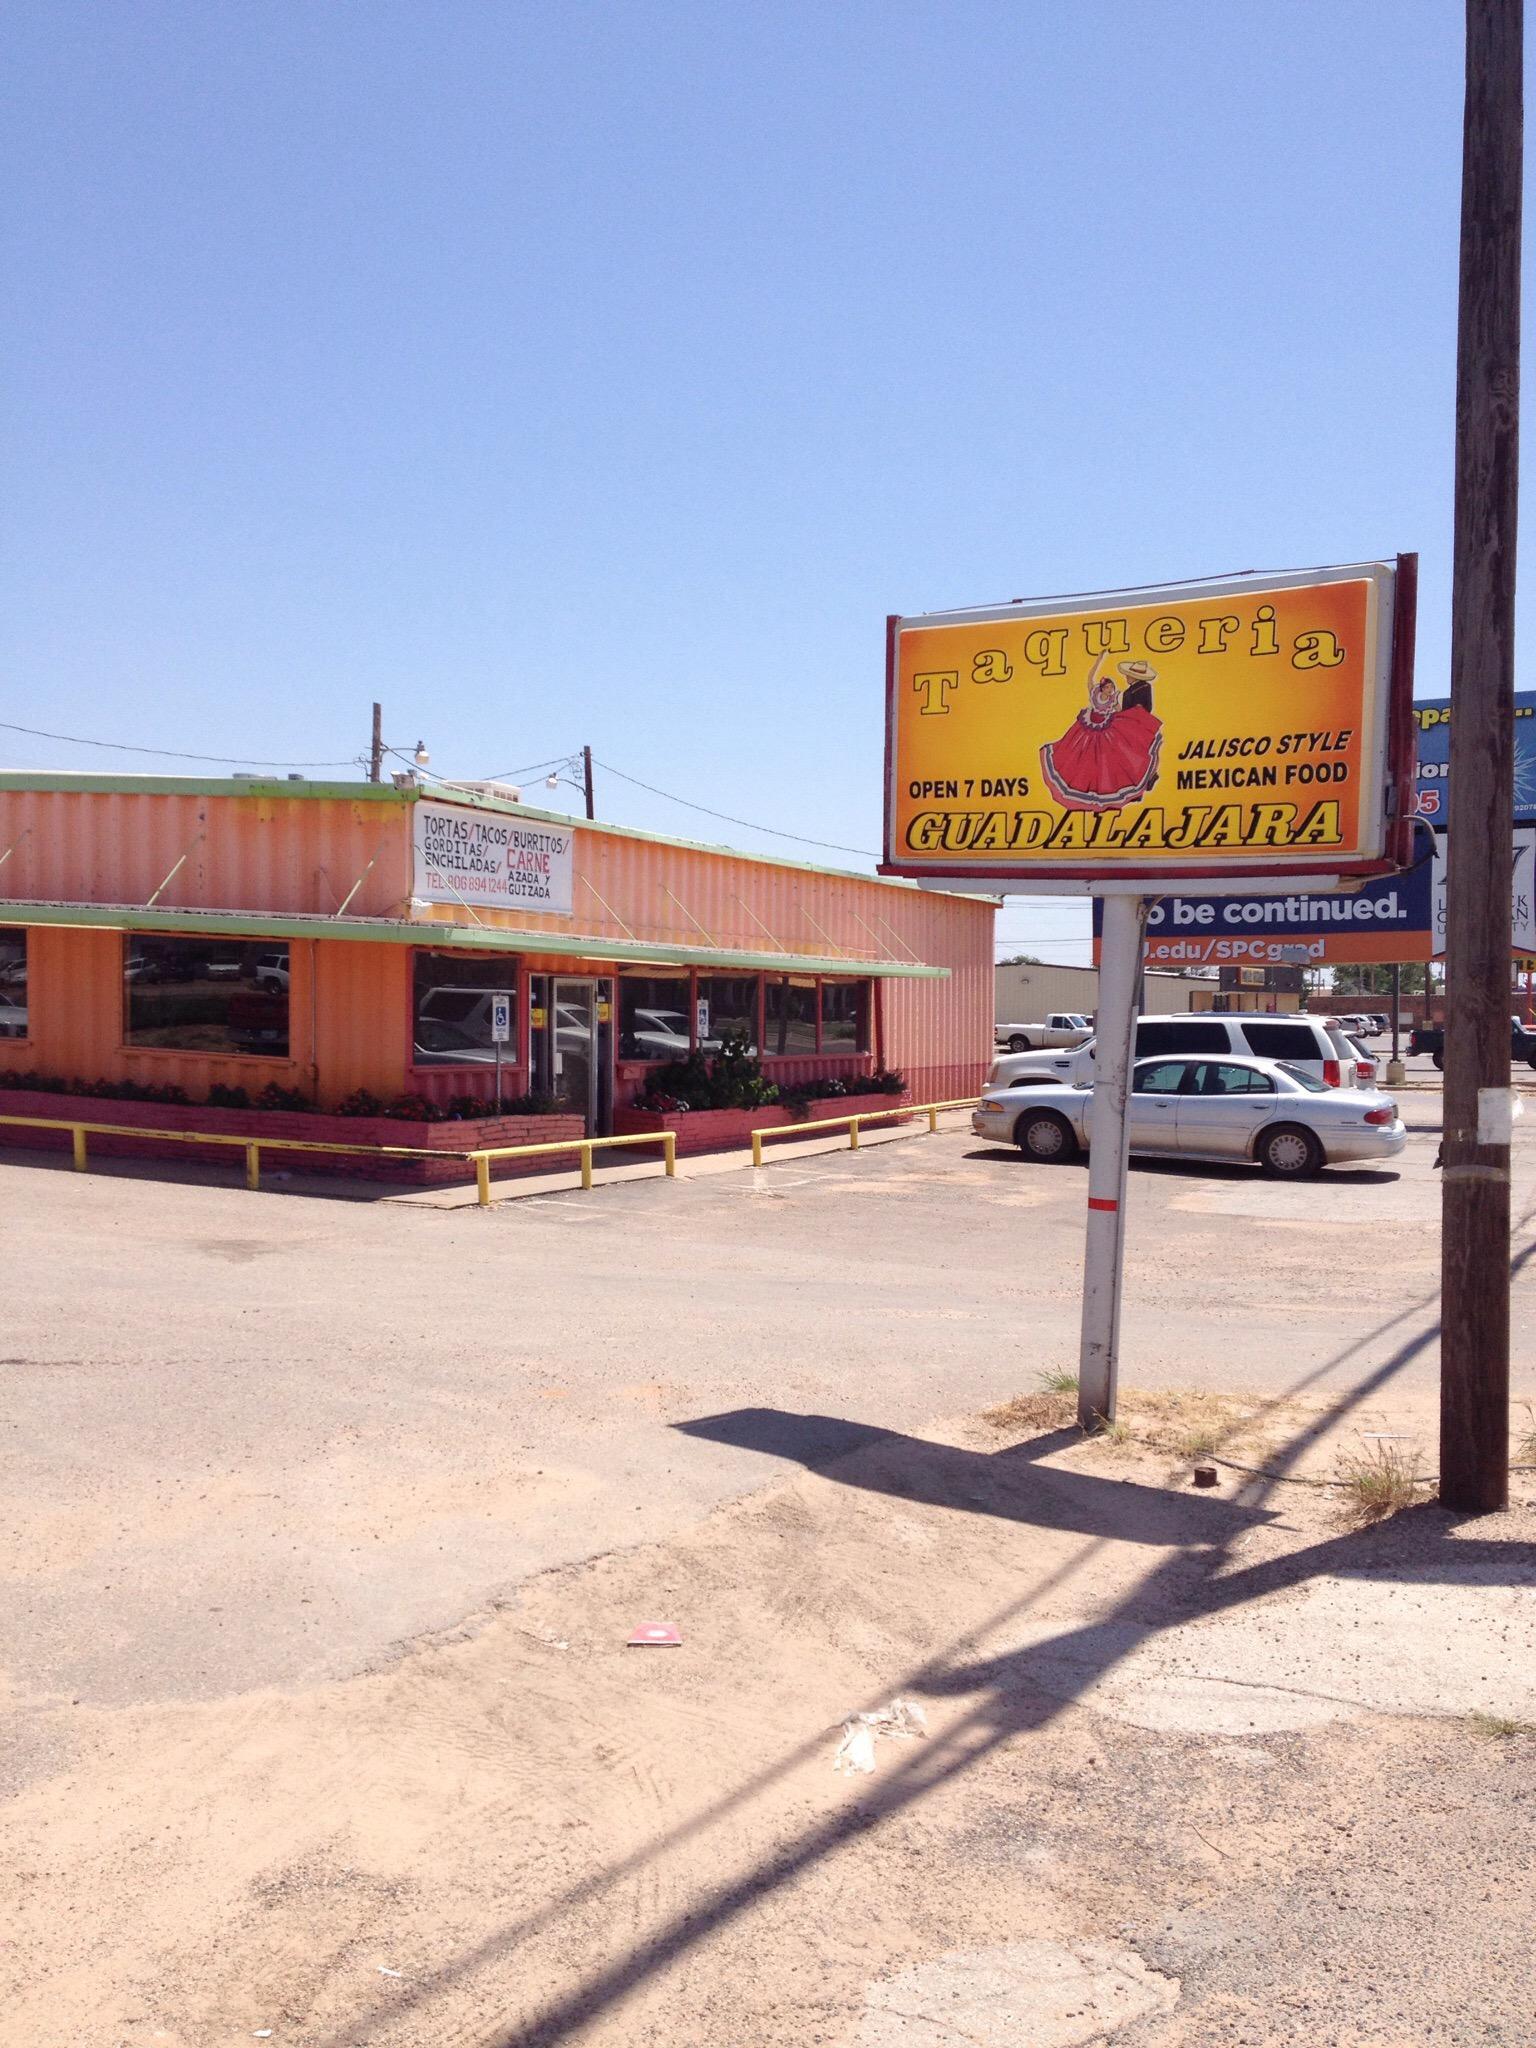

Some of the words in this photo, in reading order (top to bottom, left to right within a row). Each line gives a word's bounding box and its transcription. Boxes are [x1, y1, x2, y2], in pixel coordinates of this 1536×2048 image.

[913, 604, 1346, 716] Taqueria
[1177, 736, 1272, 760] JALISCO
[1276, 730, 1353, 755] STYLE
[909, 779, 958, 799] OPEN
[964, 779, 975, 798] 7
[980, 777, 1029, 798] DAYS
[1176, 766, 1277, 790] MEXICAN
[1285, 762, 1348, 785] FOOD
[905, 800, 1343, 851] GUADALAJARA
[506, 848, 550, 874] CARNE
[507, 871, 539, 885] AZADA
[545, 874, 551, 886] Y
[508, 883, 551, 899] GUIZADA
[1173, 898, 1215, 925] be
[1222, 891, 1408, 924] continued.
